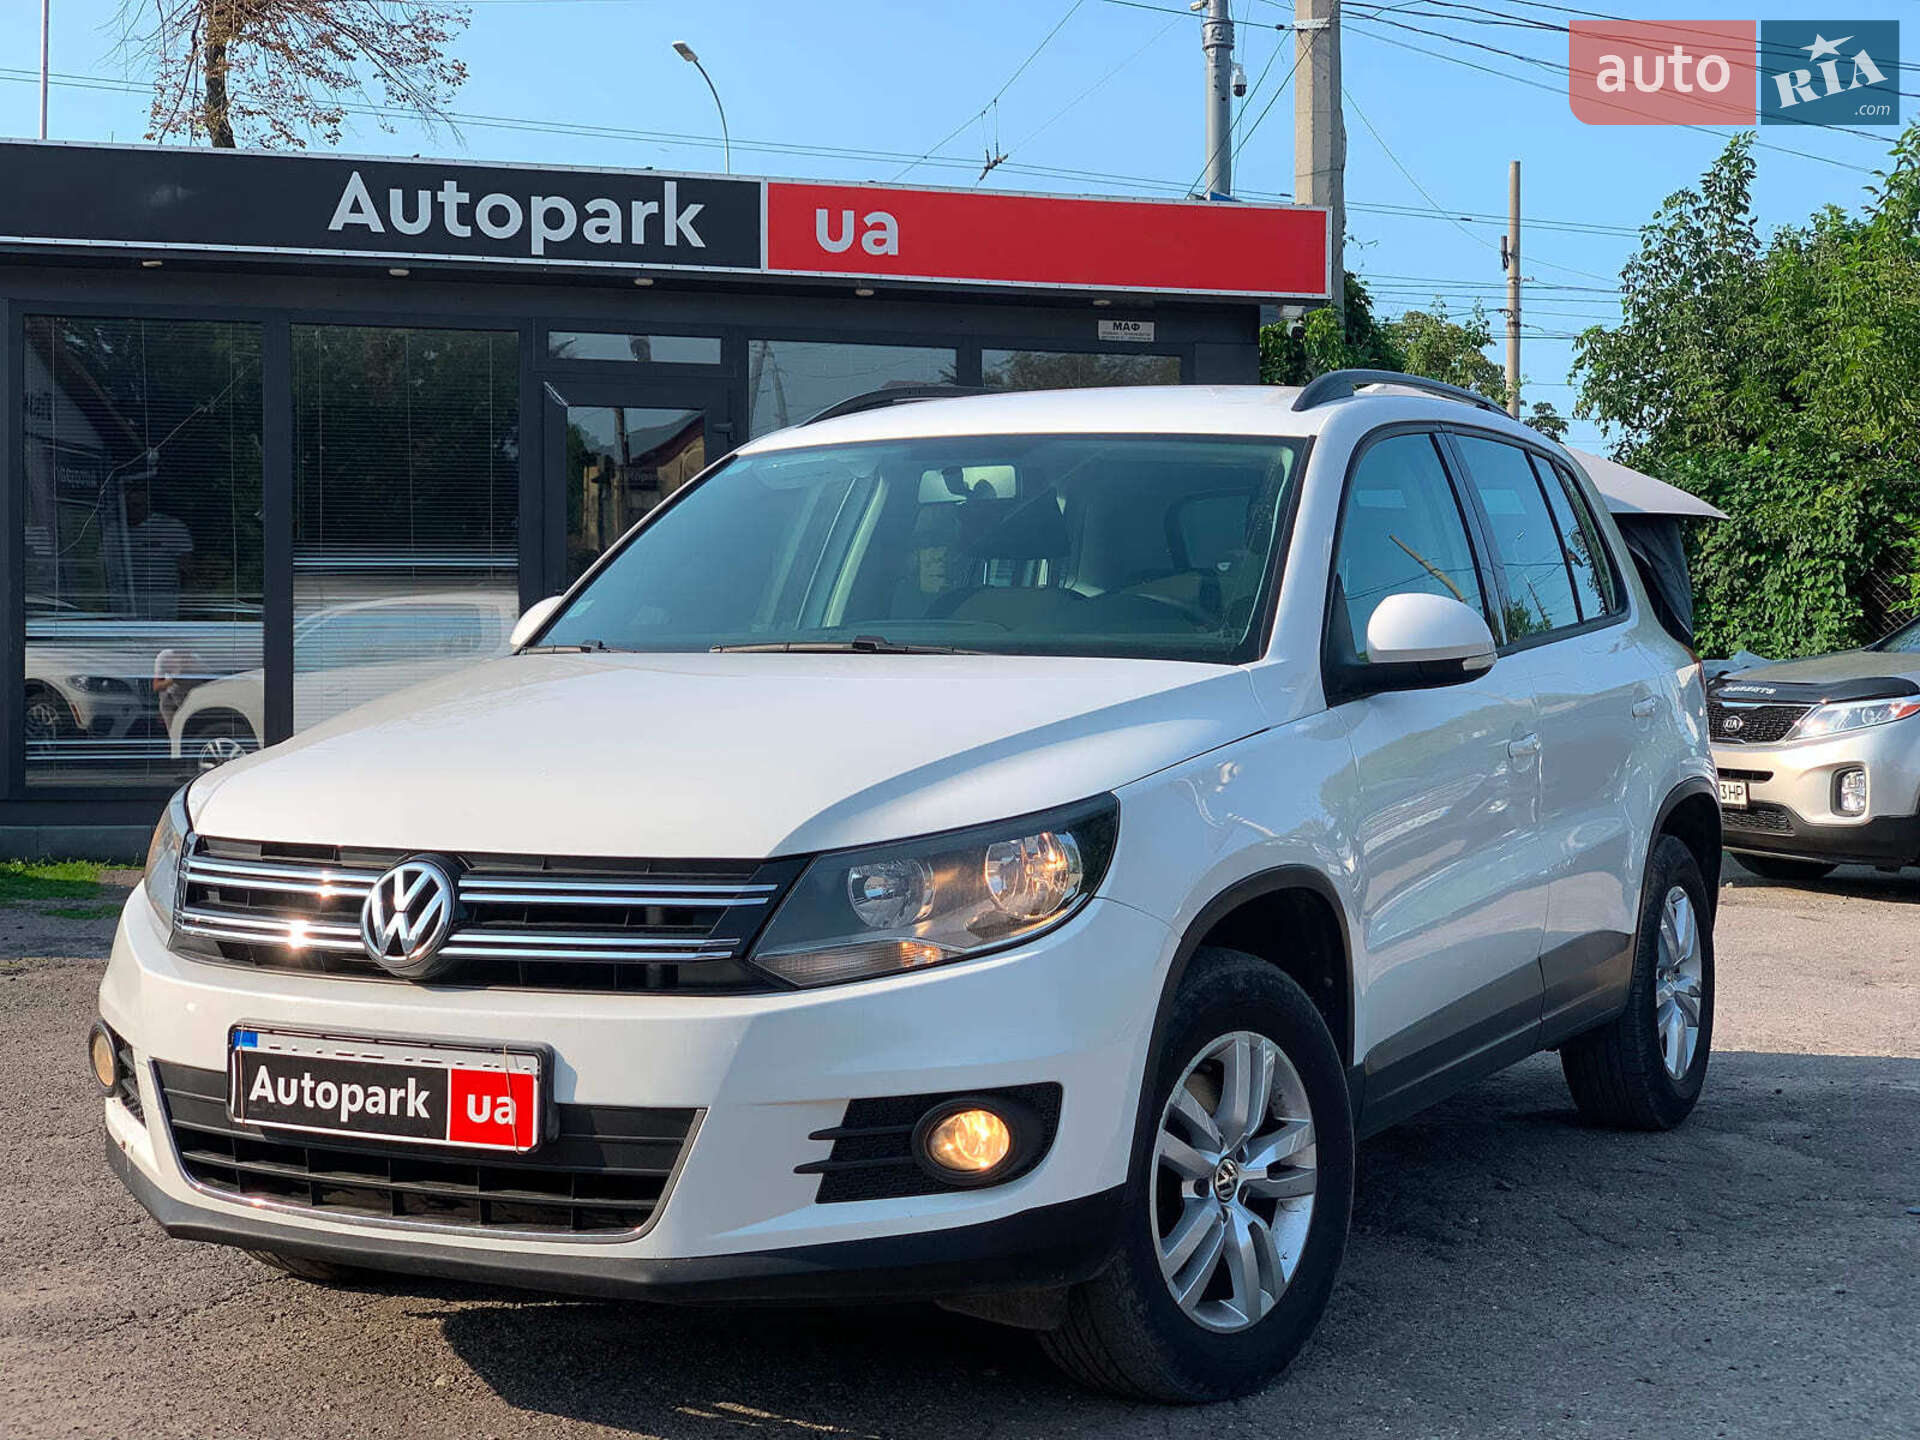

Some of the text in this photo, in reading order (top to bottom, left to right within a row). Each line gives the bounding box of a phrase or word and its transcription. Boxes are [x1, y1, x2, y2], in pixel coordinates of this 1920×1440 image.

[327, 170, 900, 256] Autopark ua
[1112, 321, 1141, 331] МАФ
[248, 1063, 517, 1126] Autopark ua
